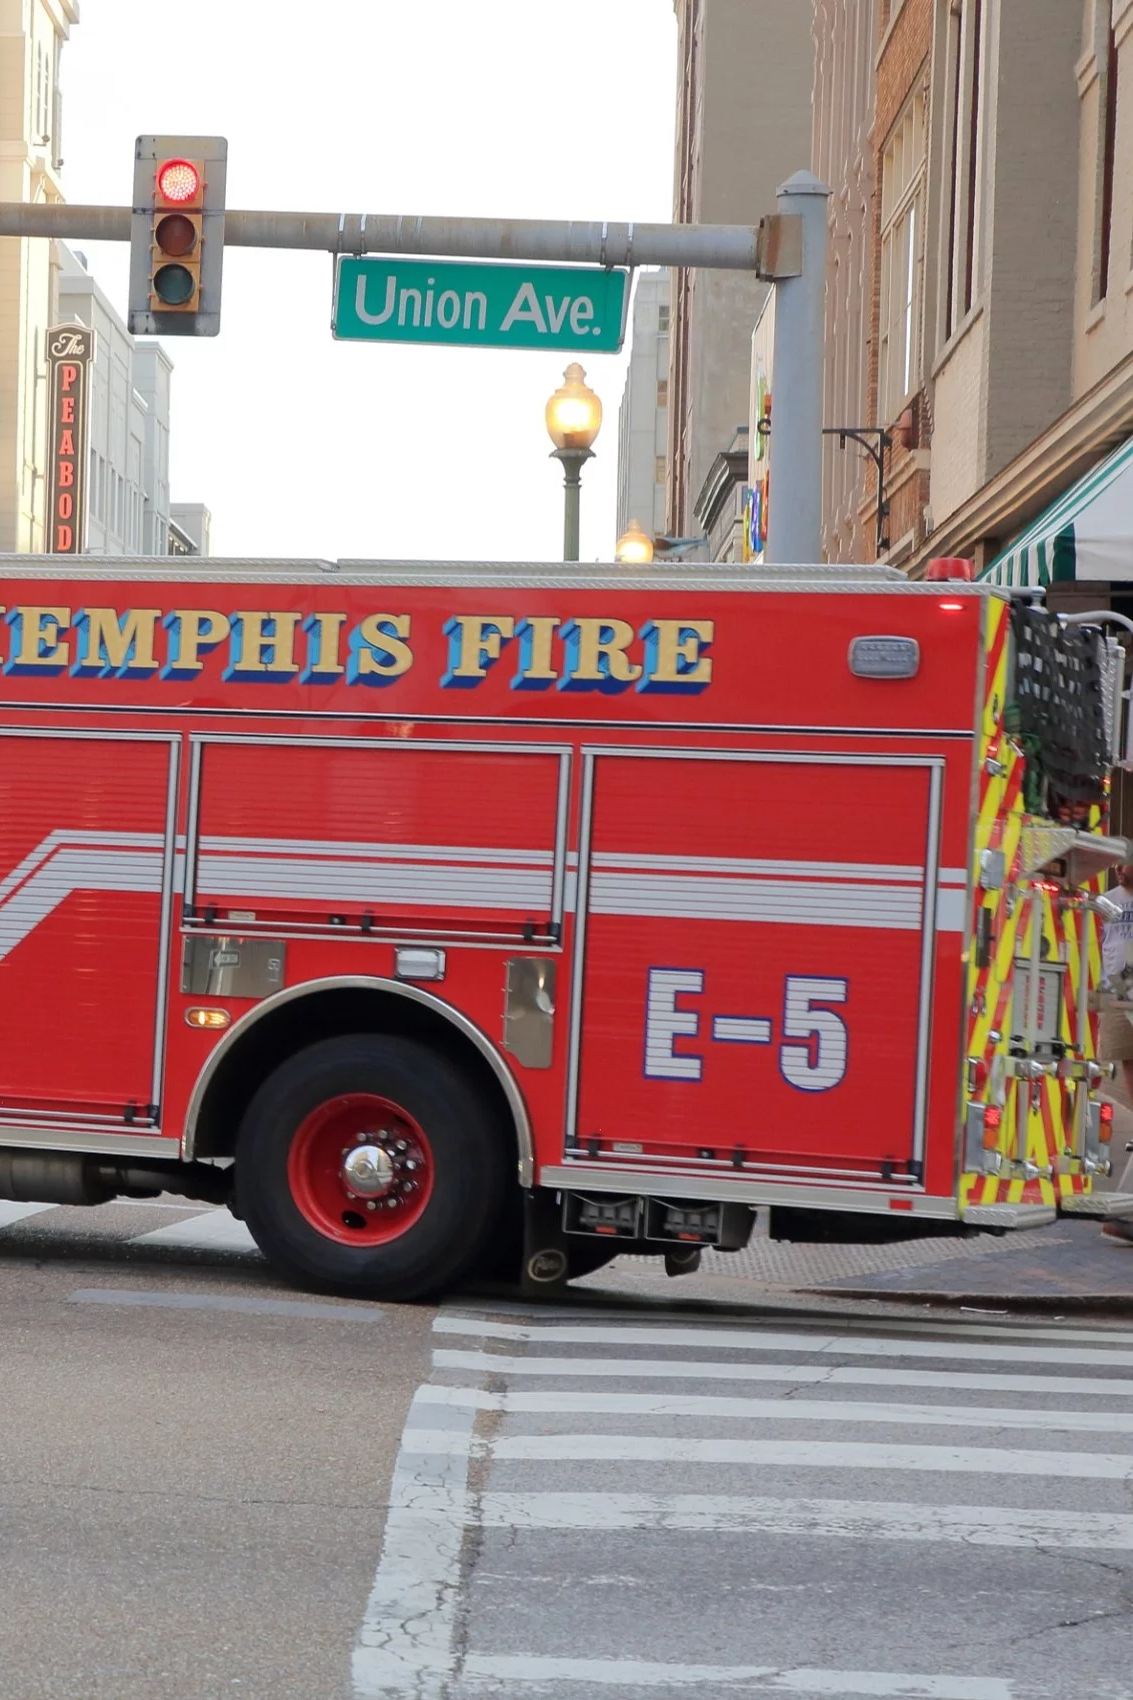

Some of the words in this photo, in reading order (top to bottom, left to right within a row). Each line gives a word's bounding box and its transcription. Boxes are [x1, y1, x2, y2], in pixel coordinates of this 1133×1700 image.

[355, 274, 487, 329] Union
[499, 282, 602, 336] Ave.
[51, 333, 85, 357] The
[440, 615, 714, 695] FIRE
[643, 966, 849, 1093] E-5
